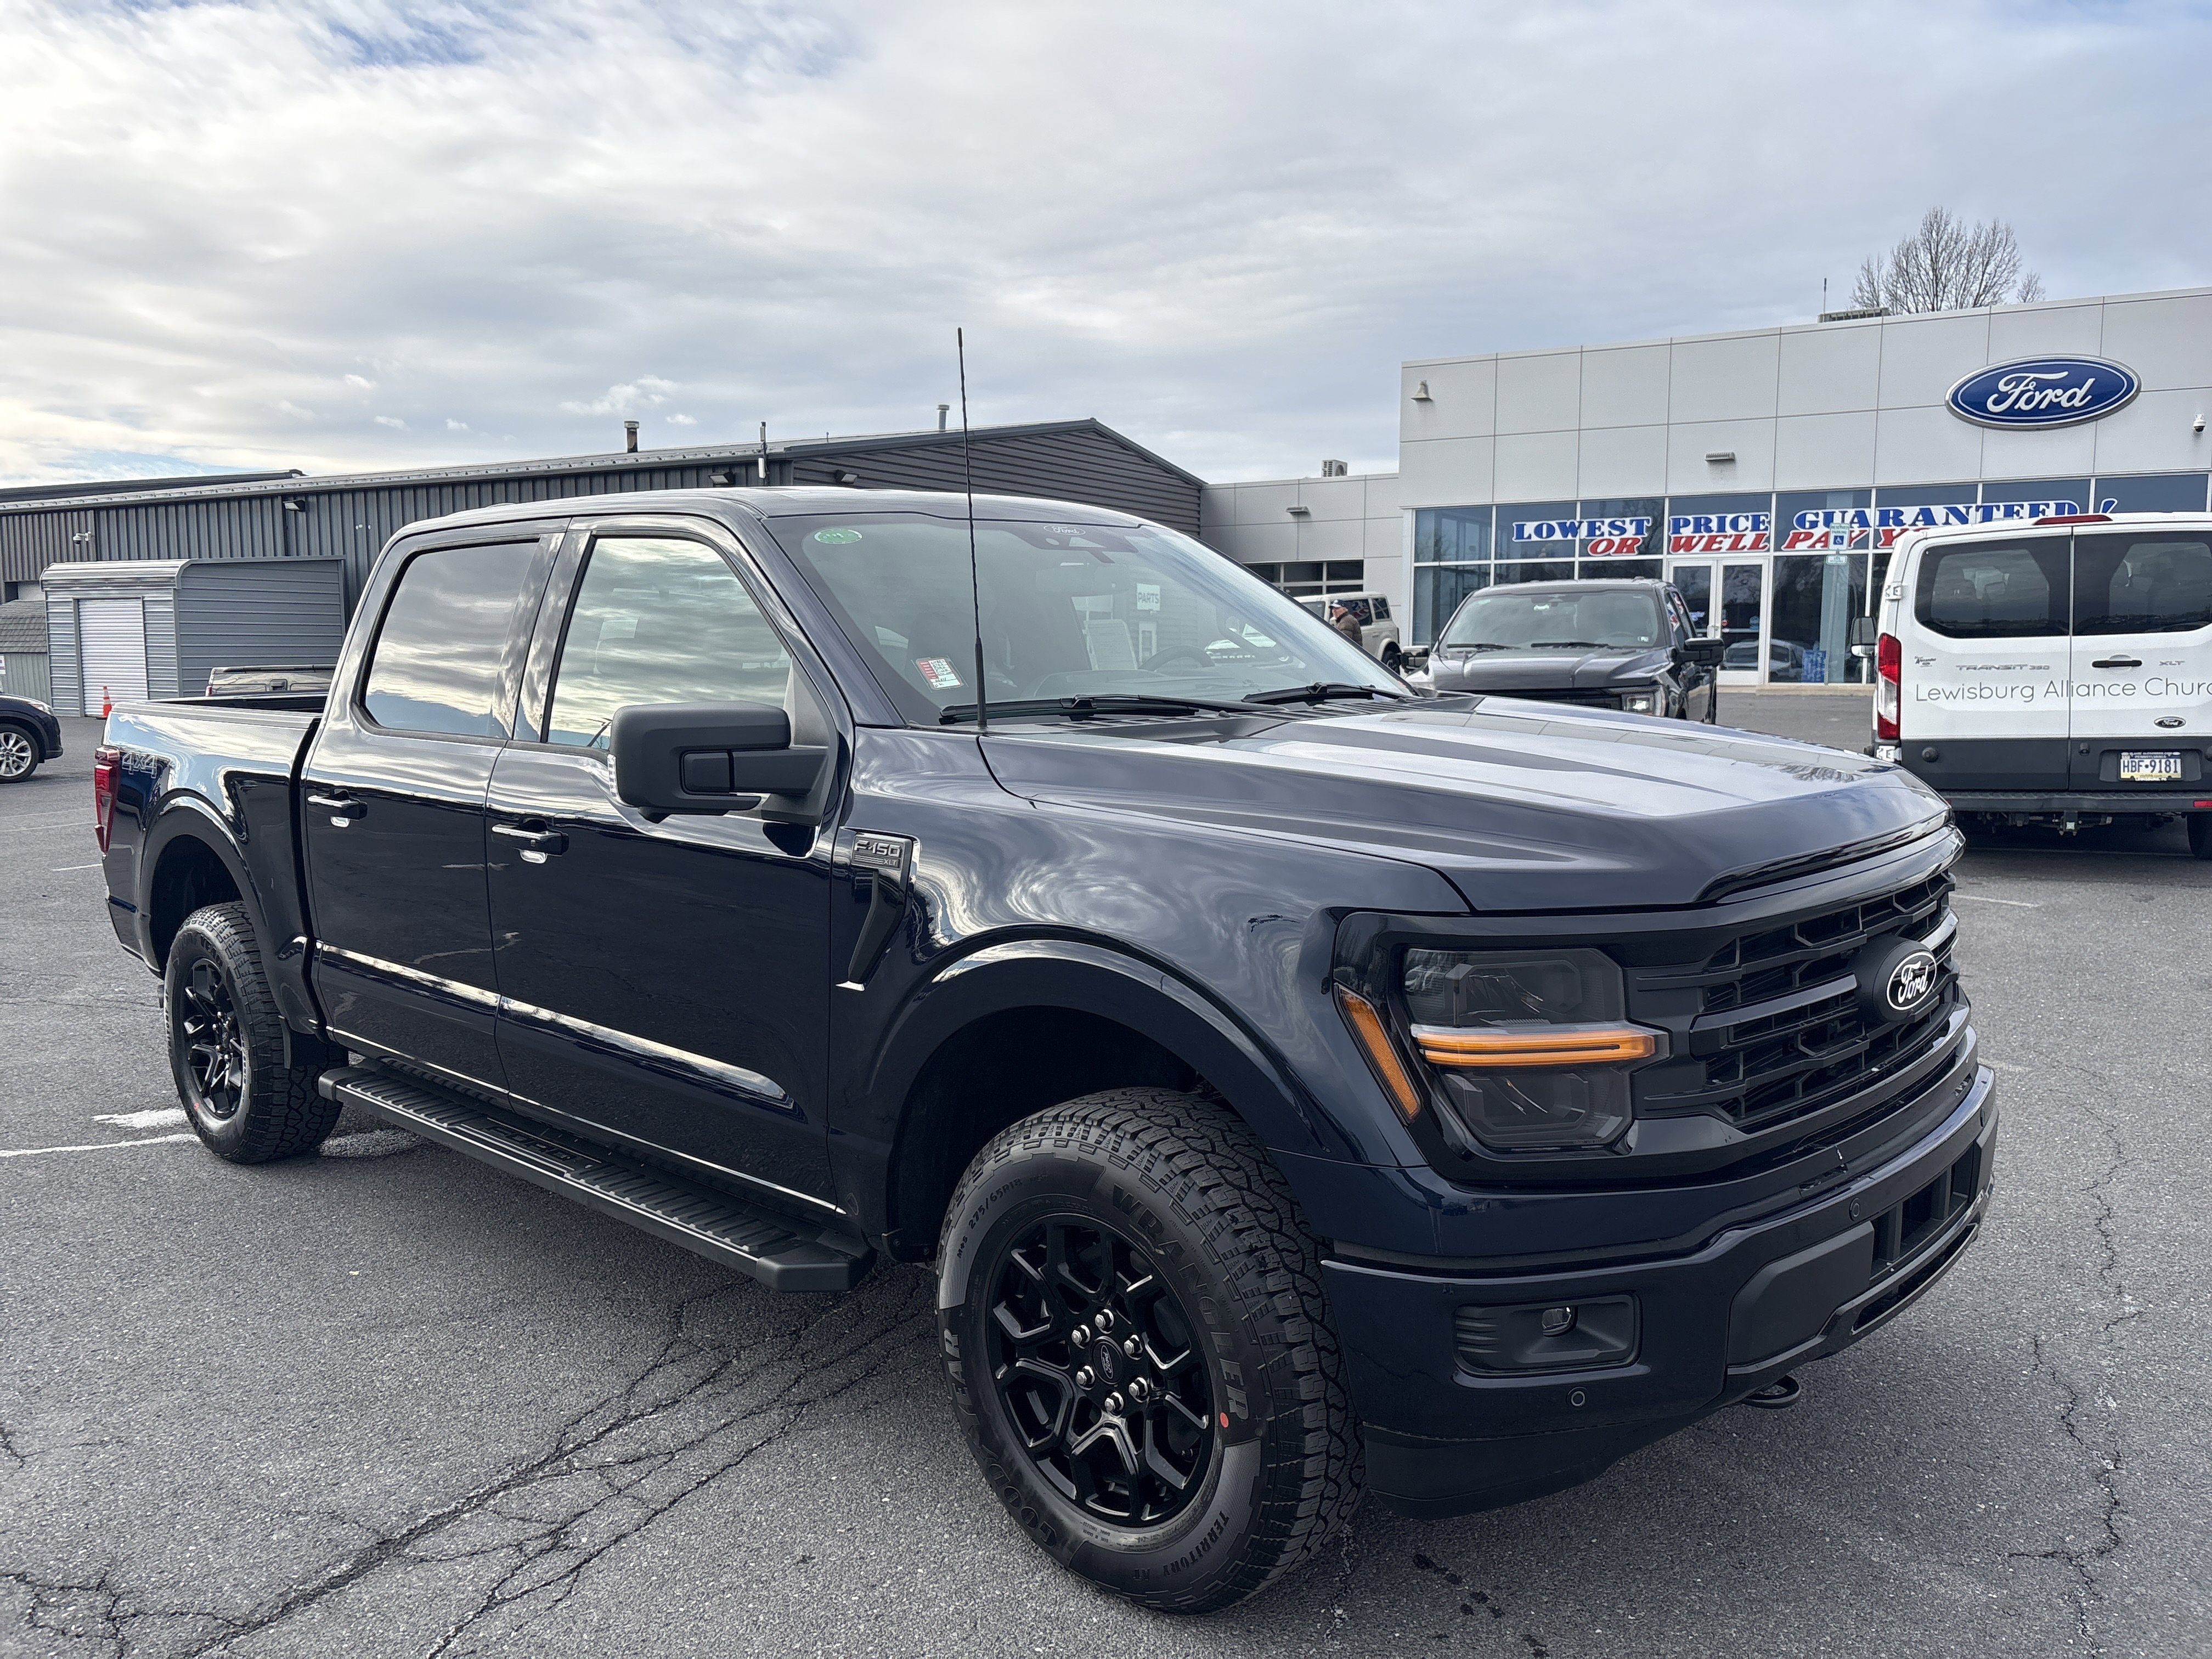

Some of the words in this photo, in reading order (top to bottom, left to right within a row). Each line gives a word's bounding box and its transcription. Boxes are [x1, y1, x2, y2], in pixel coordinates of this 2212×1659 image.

[1987, 371, 2095, 413] Ford
[1051, 526, 1080, 534] Ford
[1514, 518, 1650, 540] LOWEST
[1670, 514, 1769, 535] PRICE
[1589, 537, 1640, 555] OR
[1783, 529, 1869, 549] PAY
[1138, 592, 1159, 604] PARTS
[1916, 682, 2035, 703] Lewisburg
[2044, 679, 2136, 698] Alliance
[854, 839, 902, 857] F-150
[883, 858, 899, 867] XLT
[1898, 961, 1929, 1003] Ford
[1111, 1183, 1249, 1421] WRANGLER
[1163, 1510, 1230, 1578] TERRITORY
